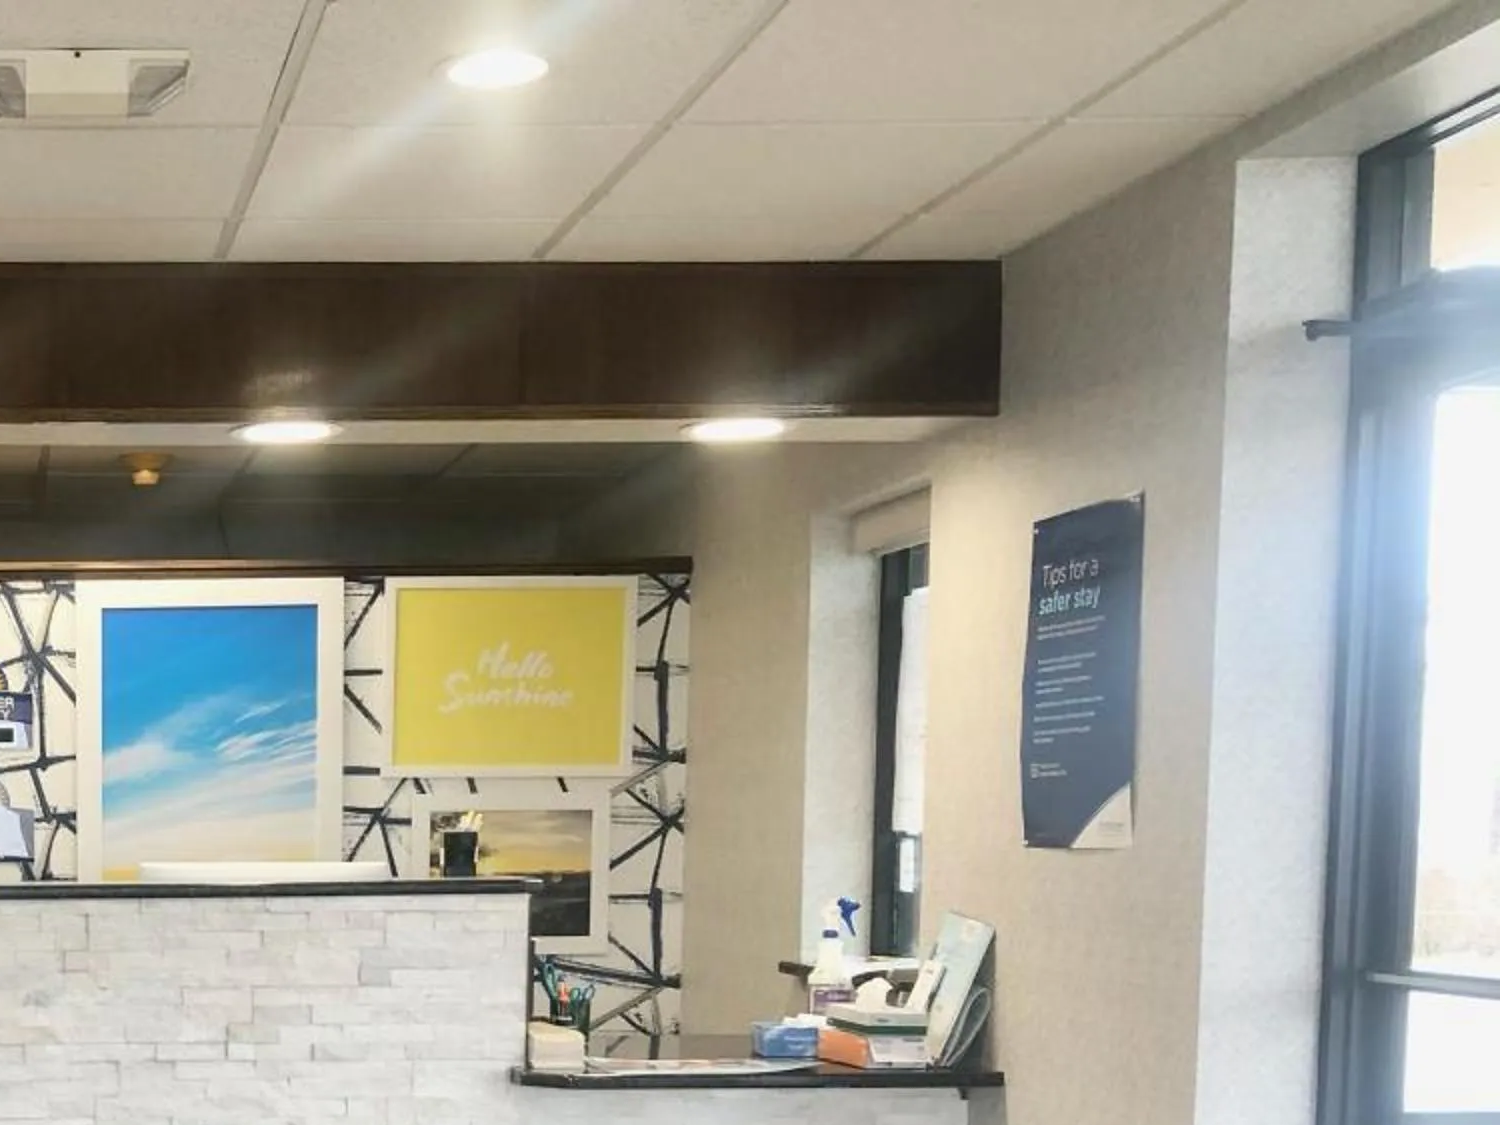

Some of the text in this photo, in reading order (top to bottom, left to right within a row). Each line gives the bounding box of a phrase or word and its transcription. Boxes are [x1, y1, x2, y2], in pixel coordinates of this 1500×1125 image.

[1043, 559, 1099, 590] Tips for a
[1039, 585, 1101, 615] safer stay
[477, 640, 554, 679] Hello
[439, 670, 573, 714] Sunshine
